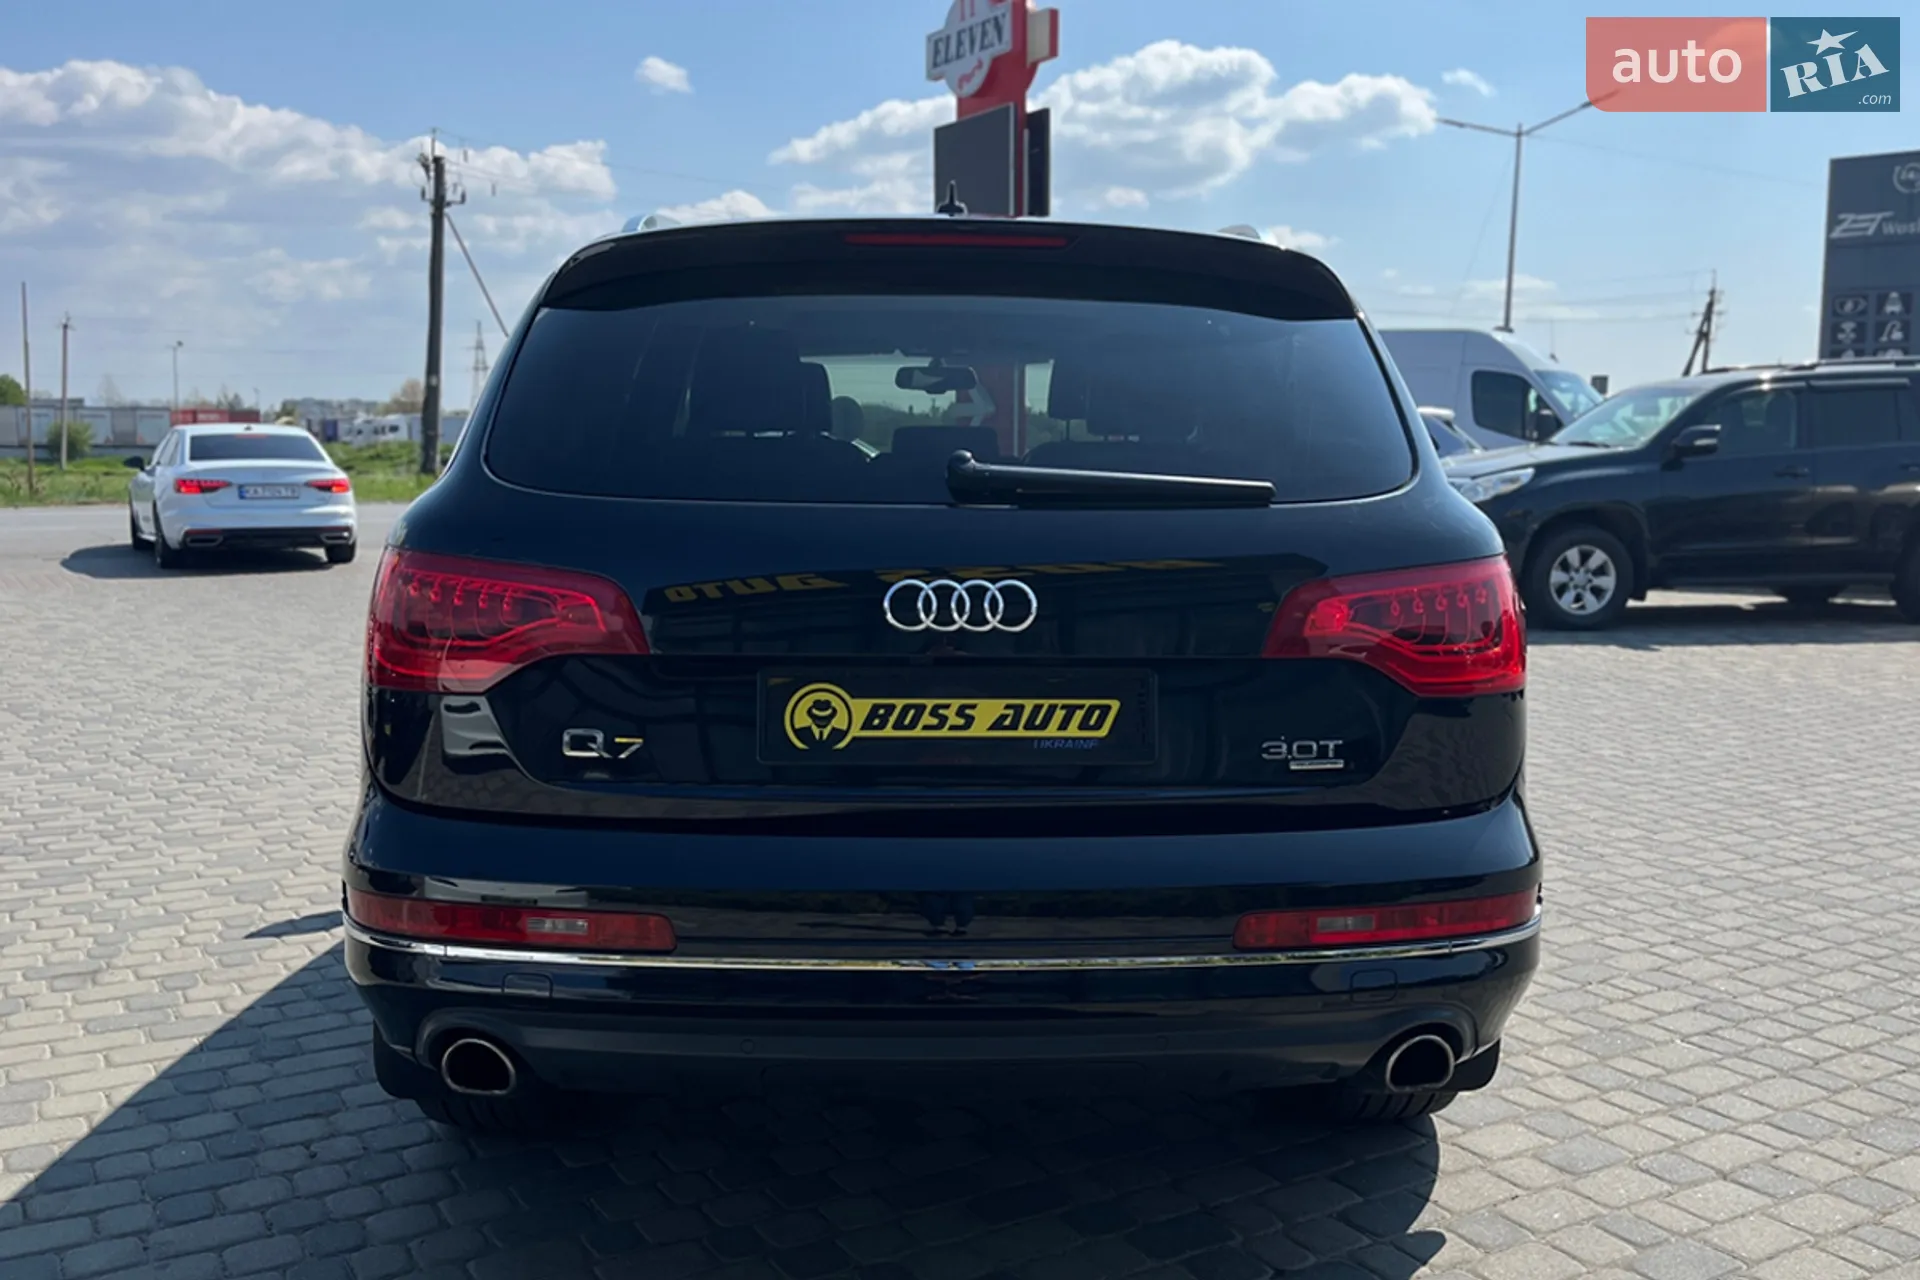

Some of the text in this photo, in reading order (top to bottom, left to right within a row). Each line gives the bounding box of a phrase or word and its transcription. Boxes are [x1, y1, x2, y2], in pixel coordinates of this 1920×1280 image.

[932, 13, 1008, 69] ELEVEN
[860, 703, 1112, 731] BOSS AUTO
[562, 728, 644, 758] Q7
